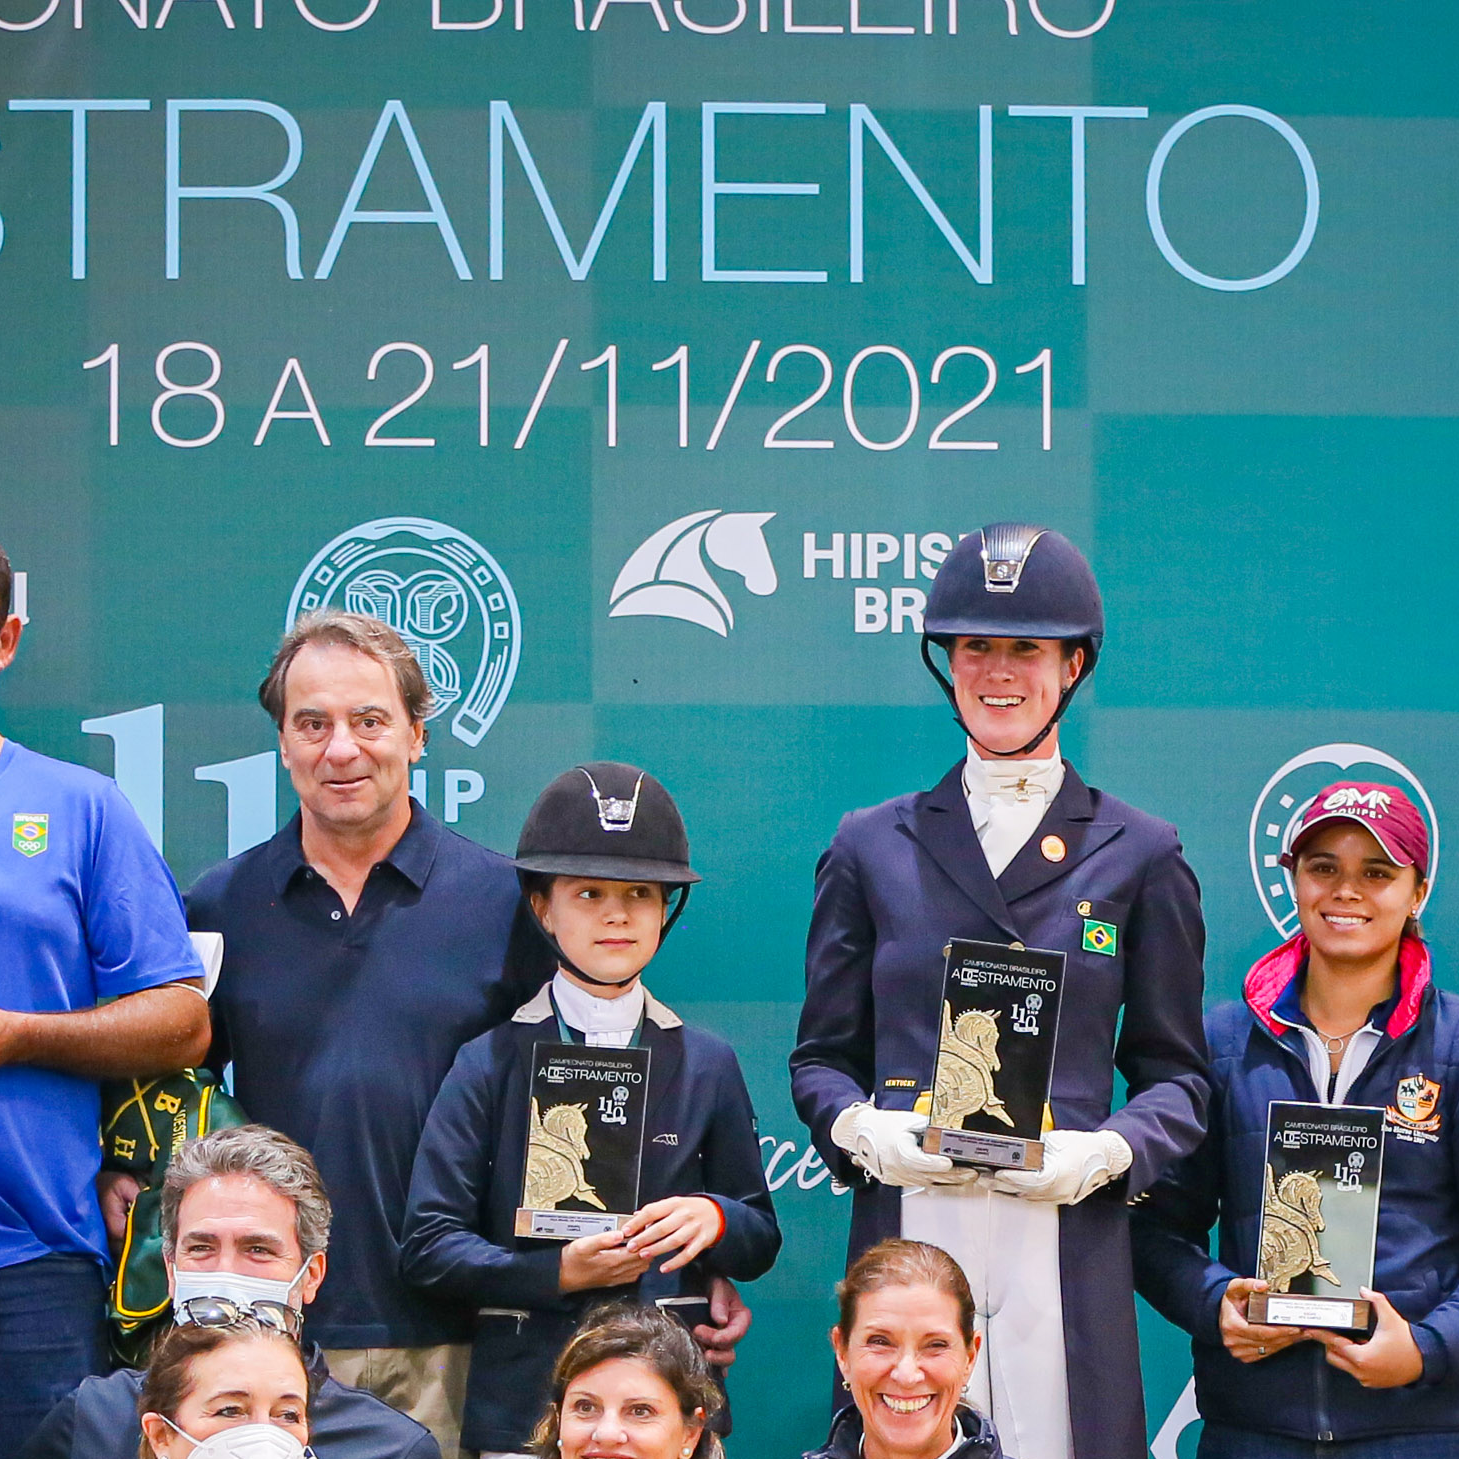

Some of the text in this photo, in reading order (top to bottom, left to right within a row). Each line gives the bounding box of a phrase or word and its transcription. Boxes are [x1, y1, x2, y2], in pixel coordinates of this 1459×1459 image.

[82, 339, 1053, 450] 18 A 21/11/2021
[803, 532, 954, 580] HIPIS
[951, 967, 1057, 992] ADESTRAMENTO
[538, 1066, 642, 1084] ADESTRAMENTO
[1273, 1130, 1377, 1149] ADESTRAMENTO
